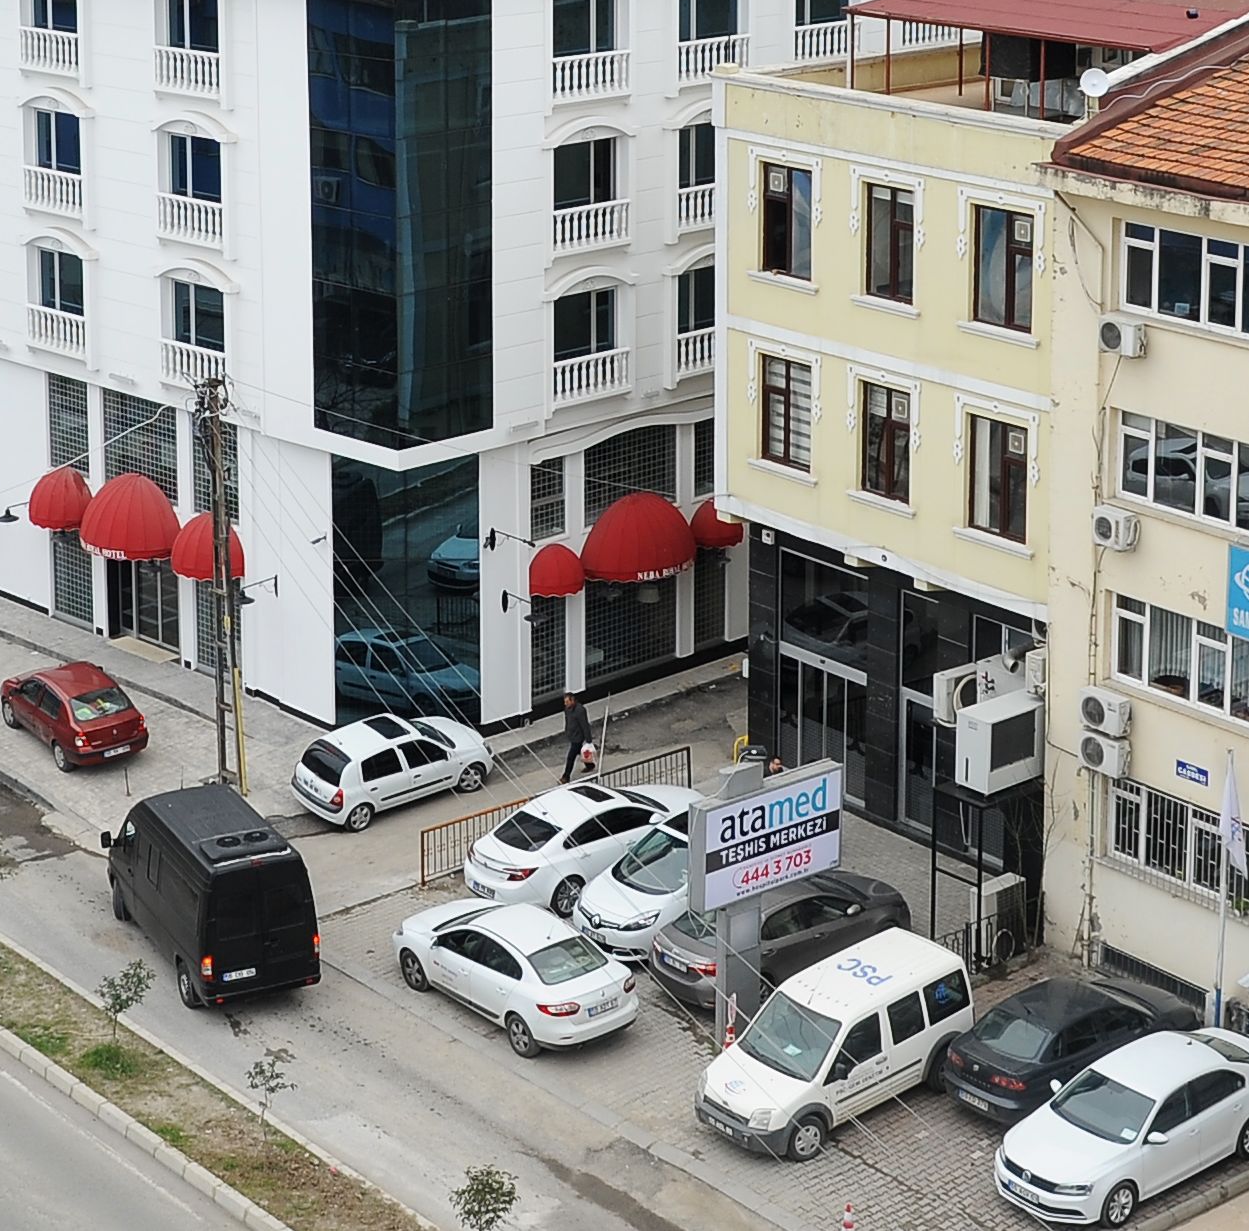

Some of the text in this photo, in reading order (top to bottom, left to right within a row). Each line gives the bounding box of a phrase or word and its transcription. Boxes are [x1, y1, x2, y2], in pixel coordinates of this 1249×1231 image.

[102, 548, 126, 560] HOTEL
[720, 778, 827, 843] atamed
[741, 864, 770, 886] 444
[773, 859, 782, 876] 3
[786, 848, 812, 872] 703
